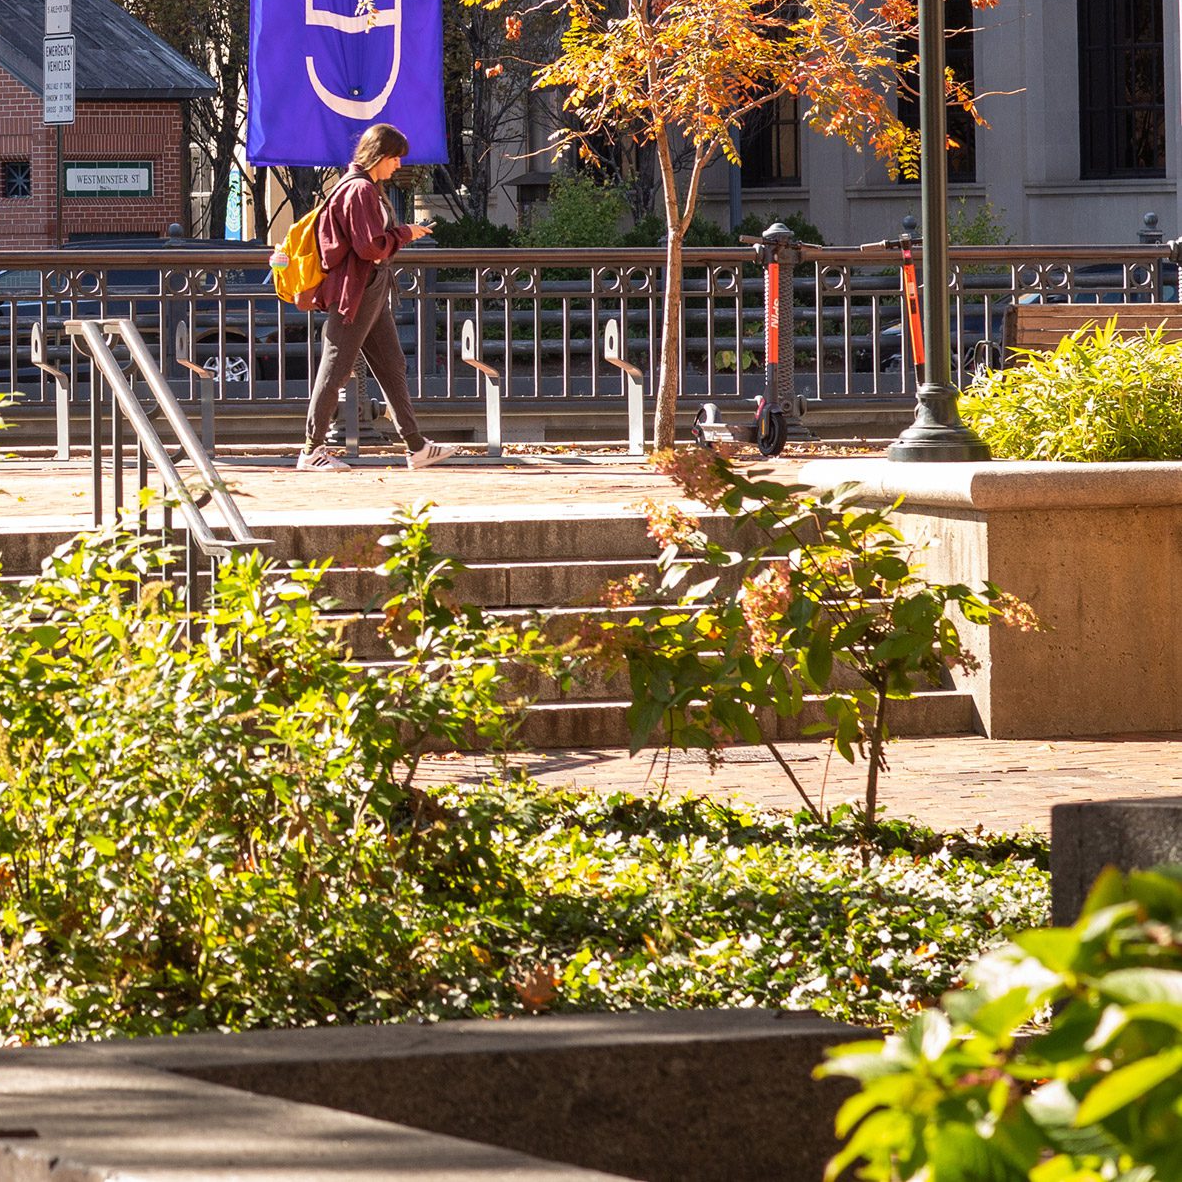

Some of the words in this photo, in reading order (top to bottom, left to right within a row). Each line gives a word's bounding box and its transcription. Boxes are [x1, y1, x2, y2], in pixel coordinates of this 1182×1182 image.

[46, 45, 72, 57] EMERGENCY
[47, 60, 71, 72] VEHICLES
[77, 174, 128, 185] WESTMINSTER
[131, 173, 140, 184] ST
